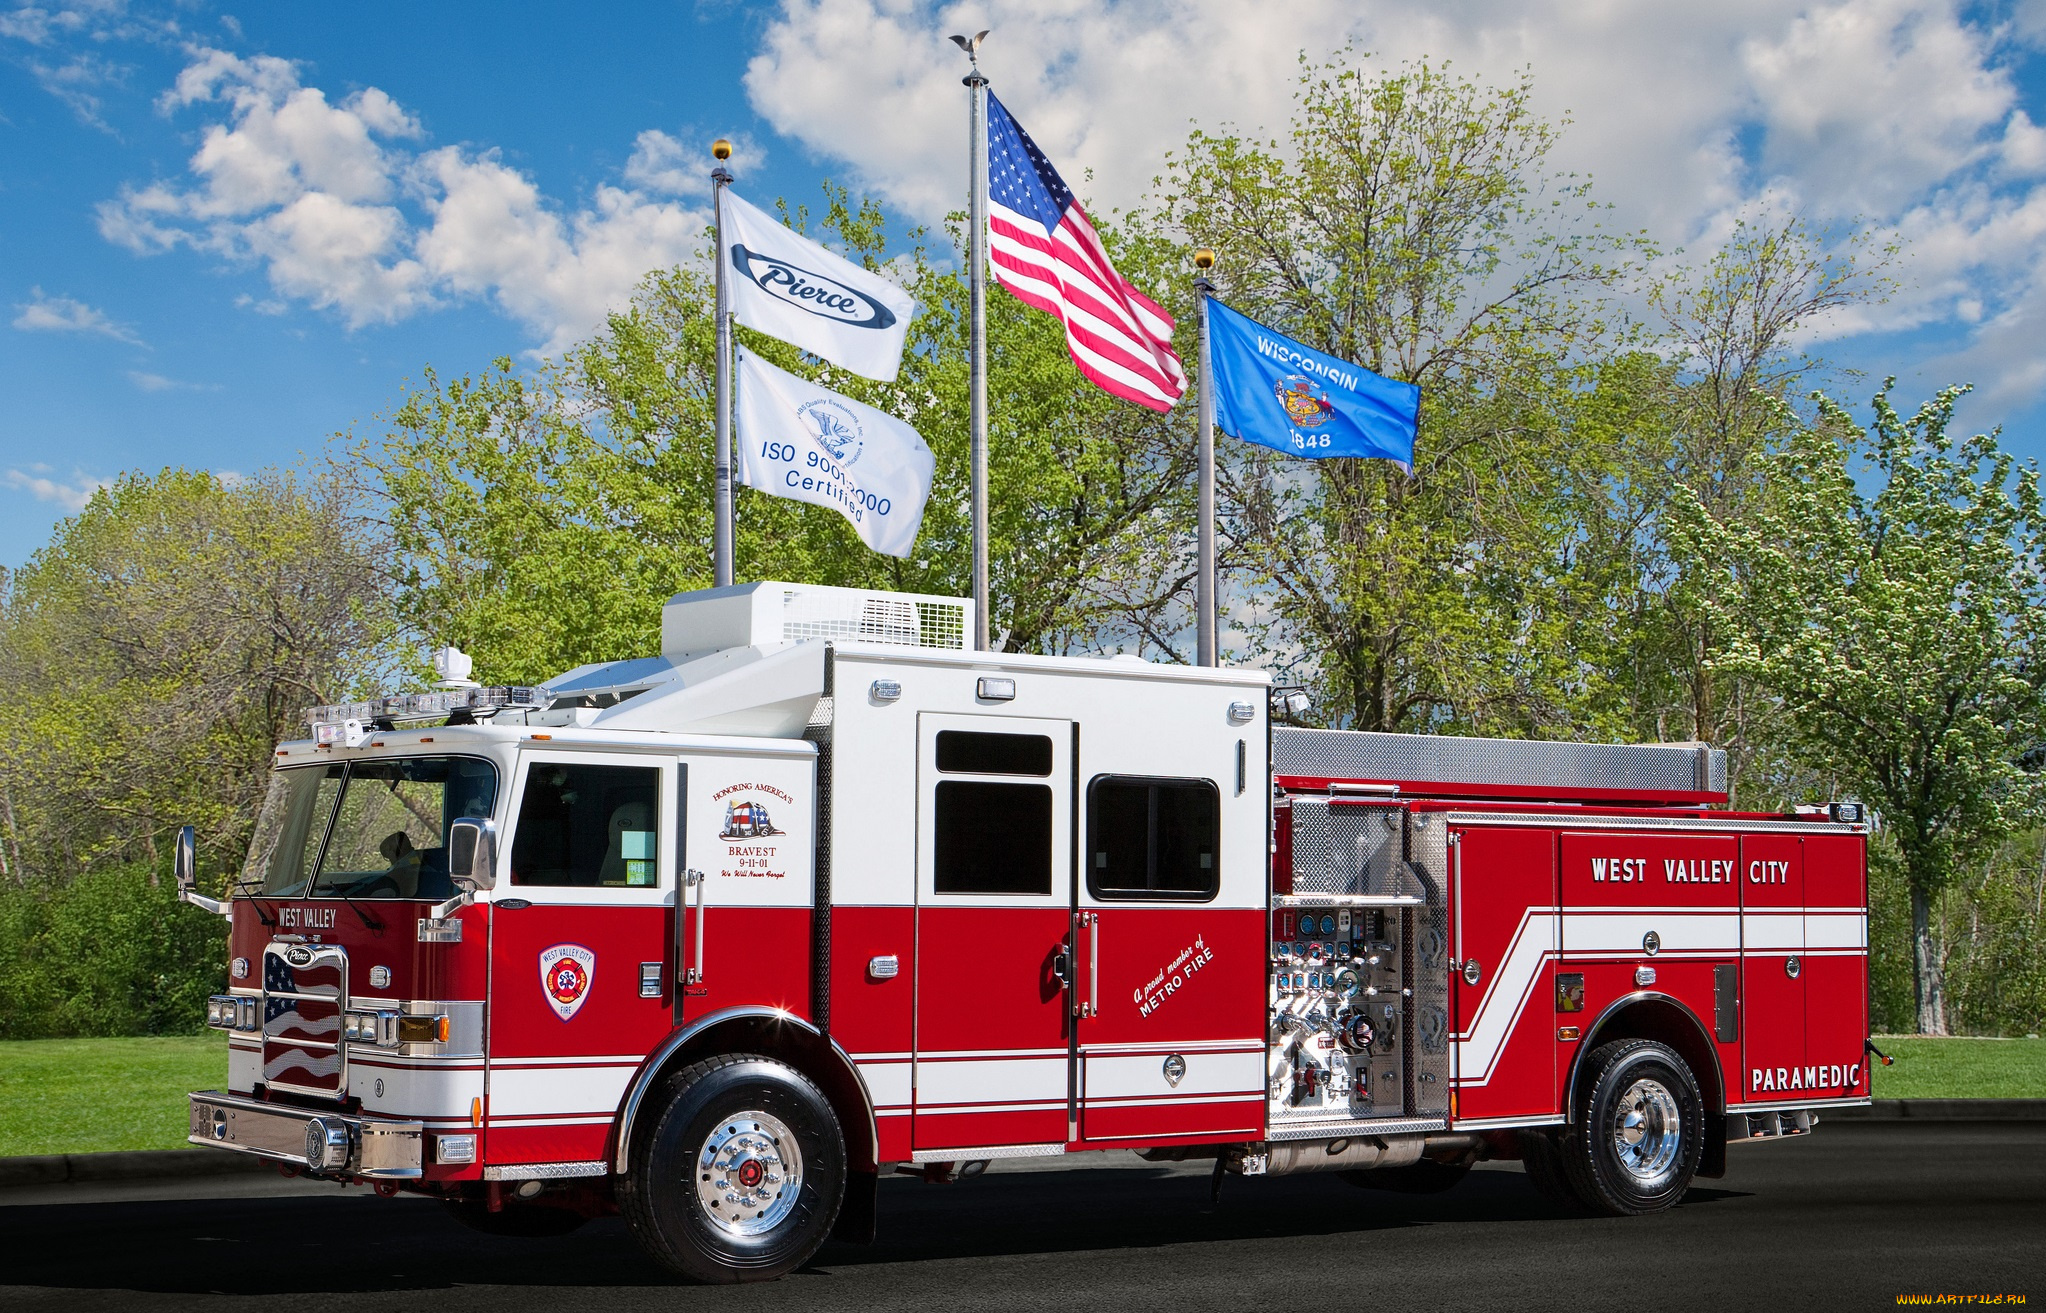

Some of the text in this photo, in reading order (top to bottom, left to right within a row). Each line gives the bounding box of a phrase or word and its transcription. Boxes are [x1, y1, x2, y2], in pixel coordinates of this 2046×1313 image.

[759, 264, 857, 314] Pierce
[1257, 335, 1359, 392] WISCONSIN
[805, 398, 827, 408] Quality
[1289, 428, 1331, 449] 1848
[761, 441, 796, 462] ISO
[785, 470, 863, 523] Certified
[712, 783, 794, 805] HONORING AMERICA'S
[728, 847, 776, 857] BRAVEST
[739, 858, 768, 868] 9-11-01
[1591, 857, 1789, 884] WEST VALLEY CITY
[721, 869, 785, 880] We Will Never Forget
[279, 908, 337, 928] WEST VALLEY
[543, 949, 558, 962] WEST
[559, 948, 578, 957] VALLEY
[580, 951, 592, 962] CITY
[1144, 968, 1165, 1000] proud
[1167, 946, 1194, 974] member
[1195, 933, 1204, 950] of
[1139, 947, 1214, 1018] METRO FIRE
[561, 1006, 571, 1014] FIRE
[1752, 1063, 1860, 1092] PARAMEDIC
